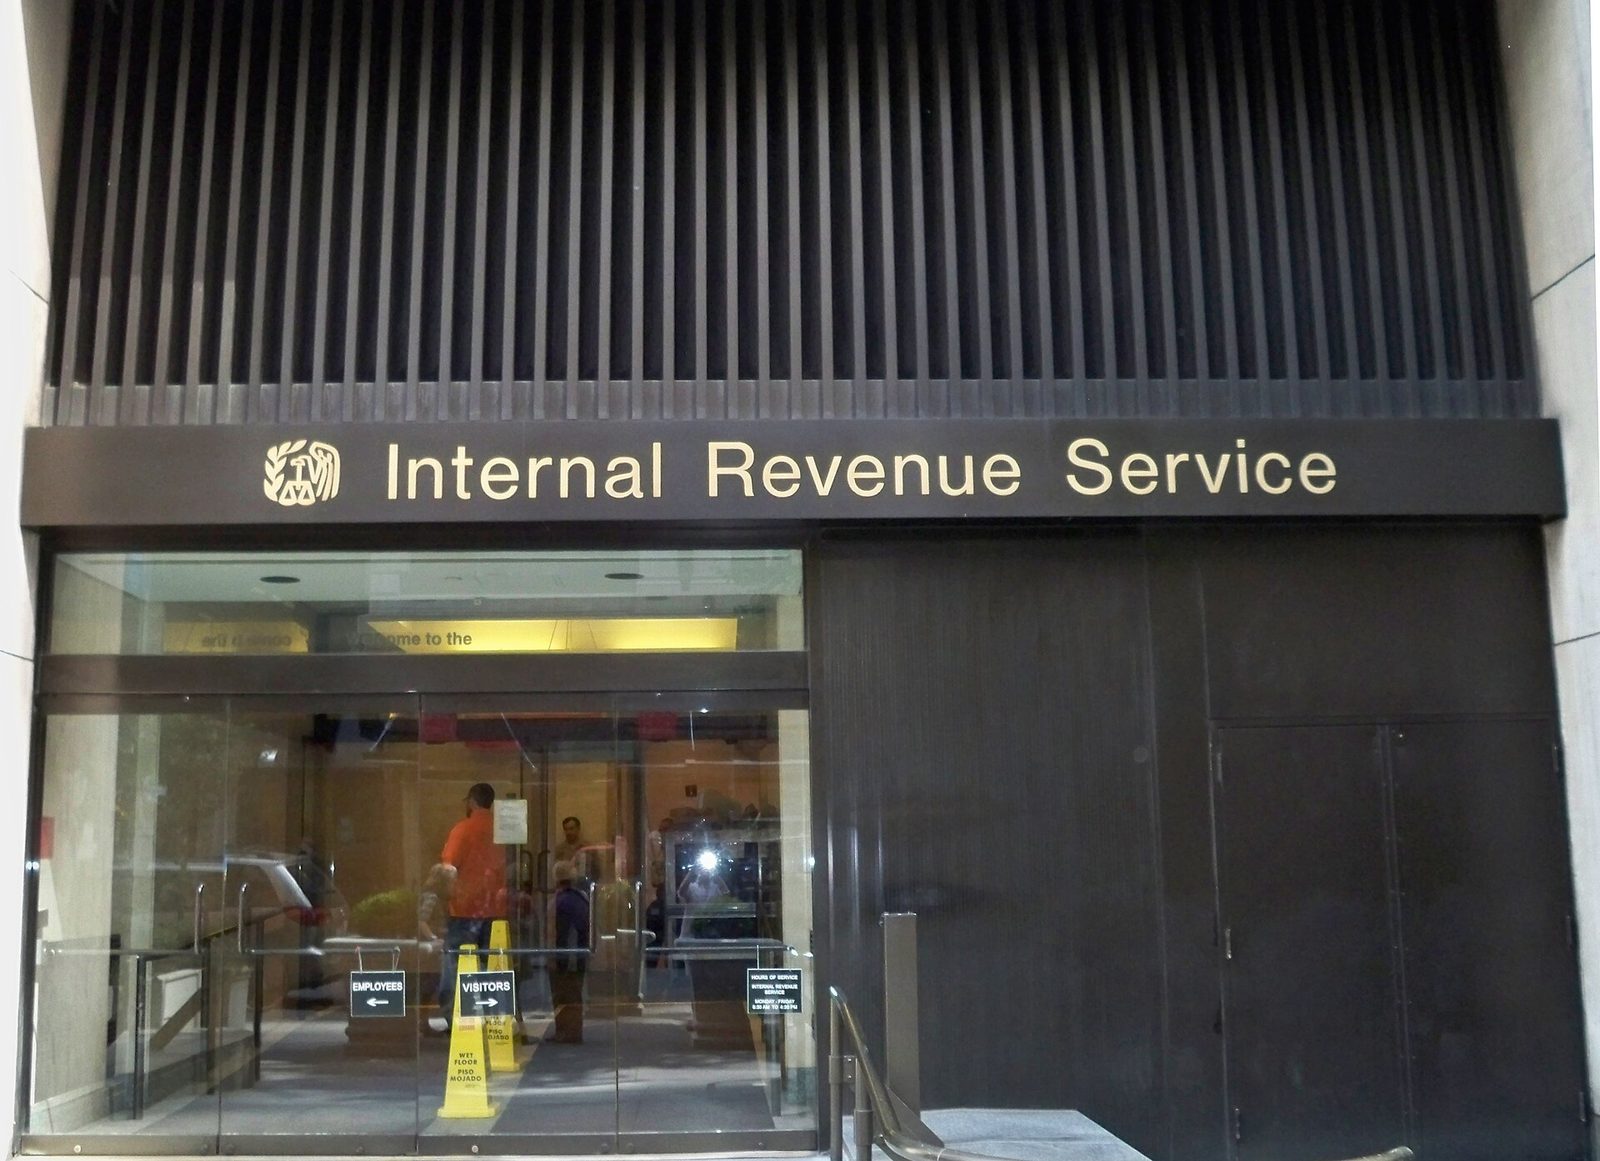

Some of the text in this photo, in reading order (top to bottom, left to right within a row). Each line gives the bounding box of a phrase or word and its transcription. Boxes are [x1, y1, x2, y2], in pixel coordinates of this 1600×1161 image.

[387, 437, 1338, 501] Internal Revenue Service
[425, 632, 442, 646] to
[446, 632, 472, 646] the
[352, 981, 403, 992] EMPLOYEES
[462, 981, 511, 993] VISITORS
